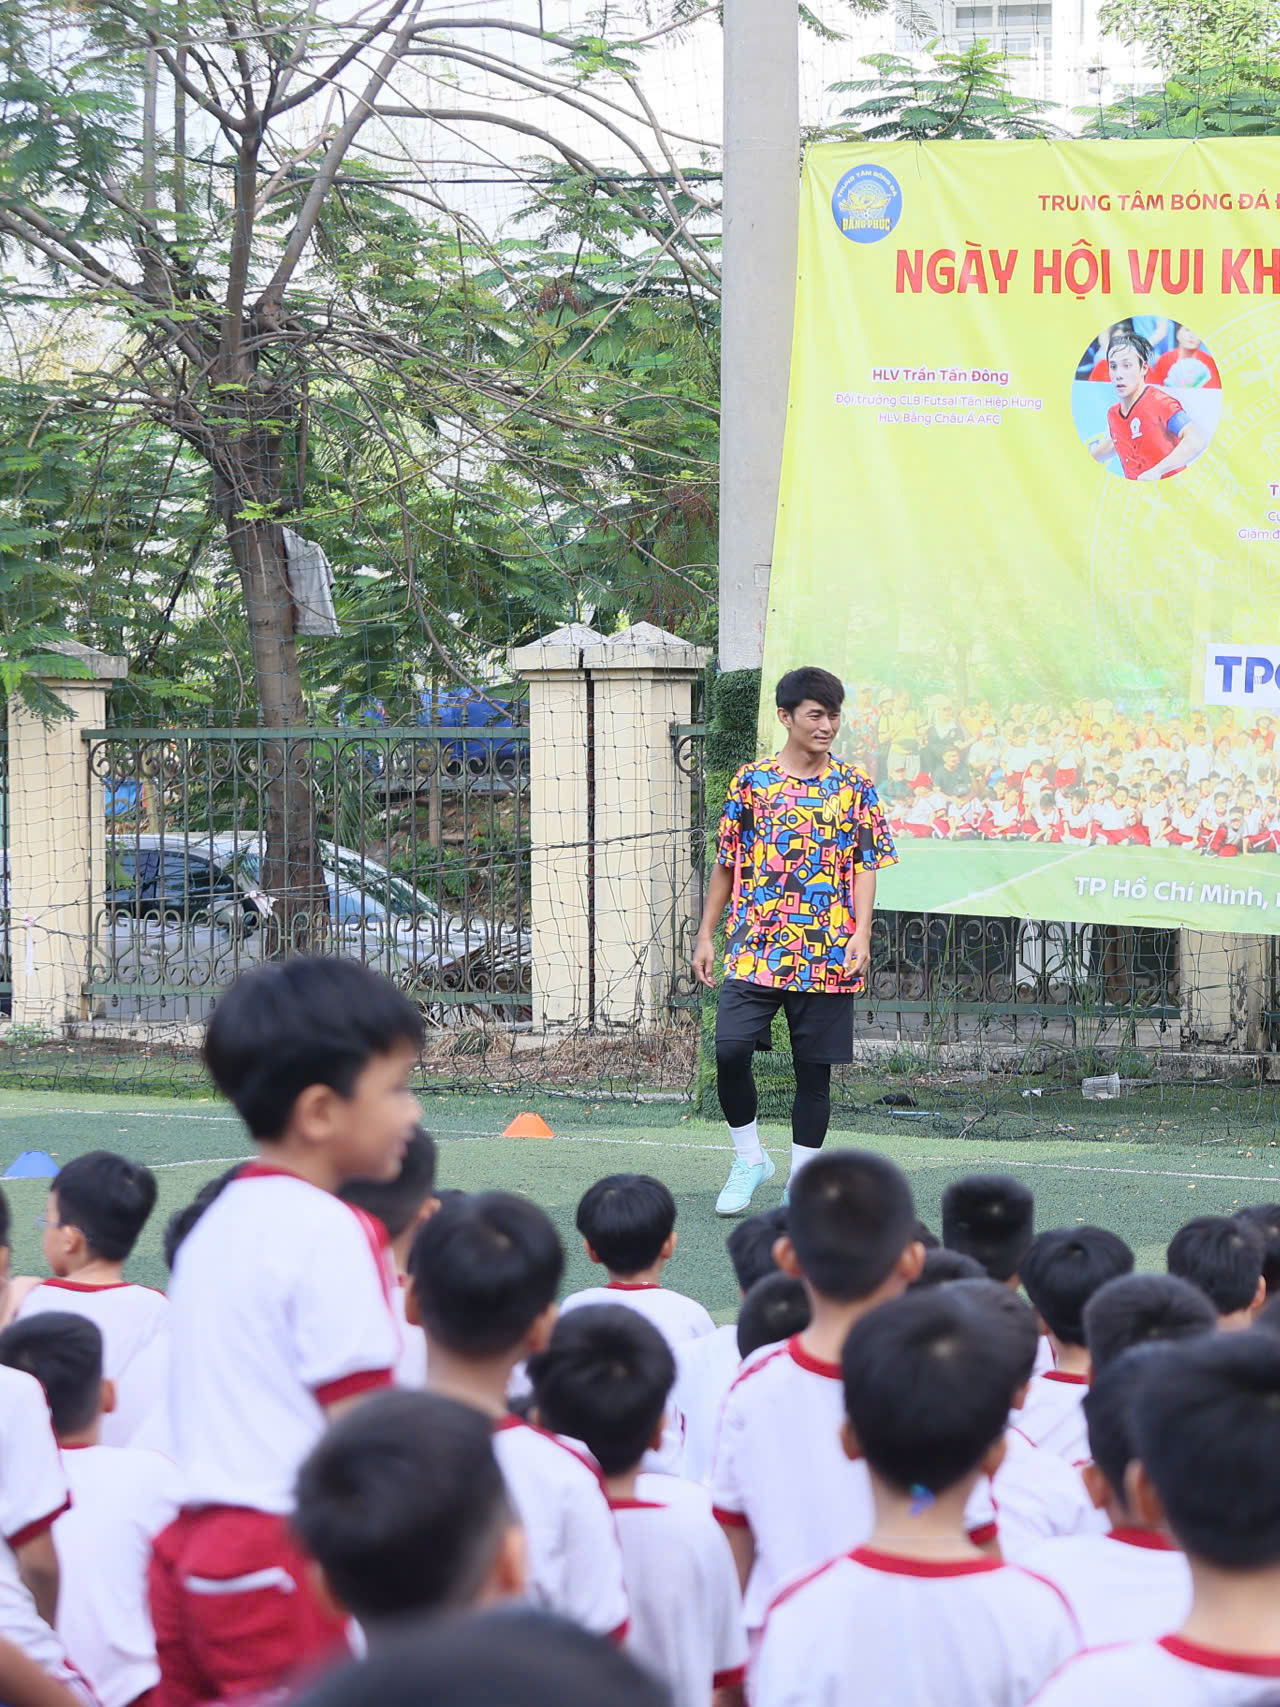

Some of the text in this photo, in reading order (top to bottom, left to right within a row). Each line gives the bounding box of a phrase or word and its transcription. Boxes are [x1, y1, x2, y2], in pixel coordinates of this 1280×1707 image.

[1038, 194, 1111, 211] TRUNG
[1118, 189, 1165, 211] TÂM
[1171, 188, 1232, 210] BÓNG
[1238, 188, 1270, 210] ĐÁ
[895, 240, 1018, 294] NGÀY
[1033, 238, 1111, 300] HỘI
[1128, 248, 1203, 294] VUI
[873, 369, 900, 381] HLV
[971, 368, 1009, 385] Đông
[900, 395, 921, 406] CLB
[924, 395, 958, 406] Futsal
[879, 412, 900, 422] HLV
[977, 413, 1001, 425] AFC
[1075, 876, 1107, 898] TP
[1112, 876, 1148, 899] Hồ
[1153, 881, 1194, 903] Chí
[1199, 884, 1269, 910] Minh,
